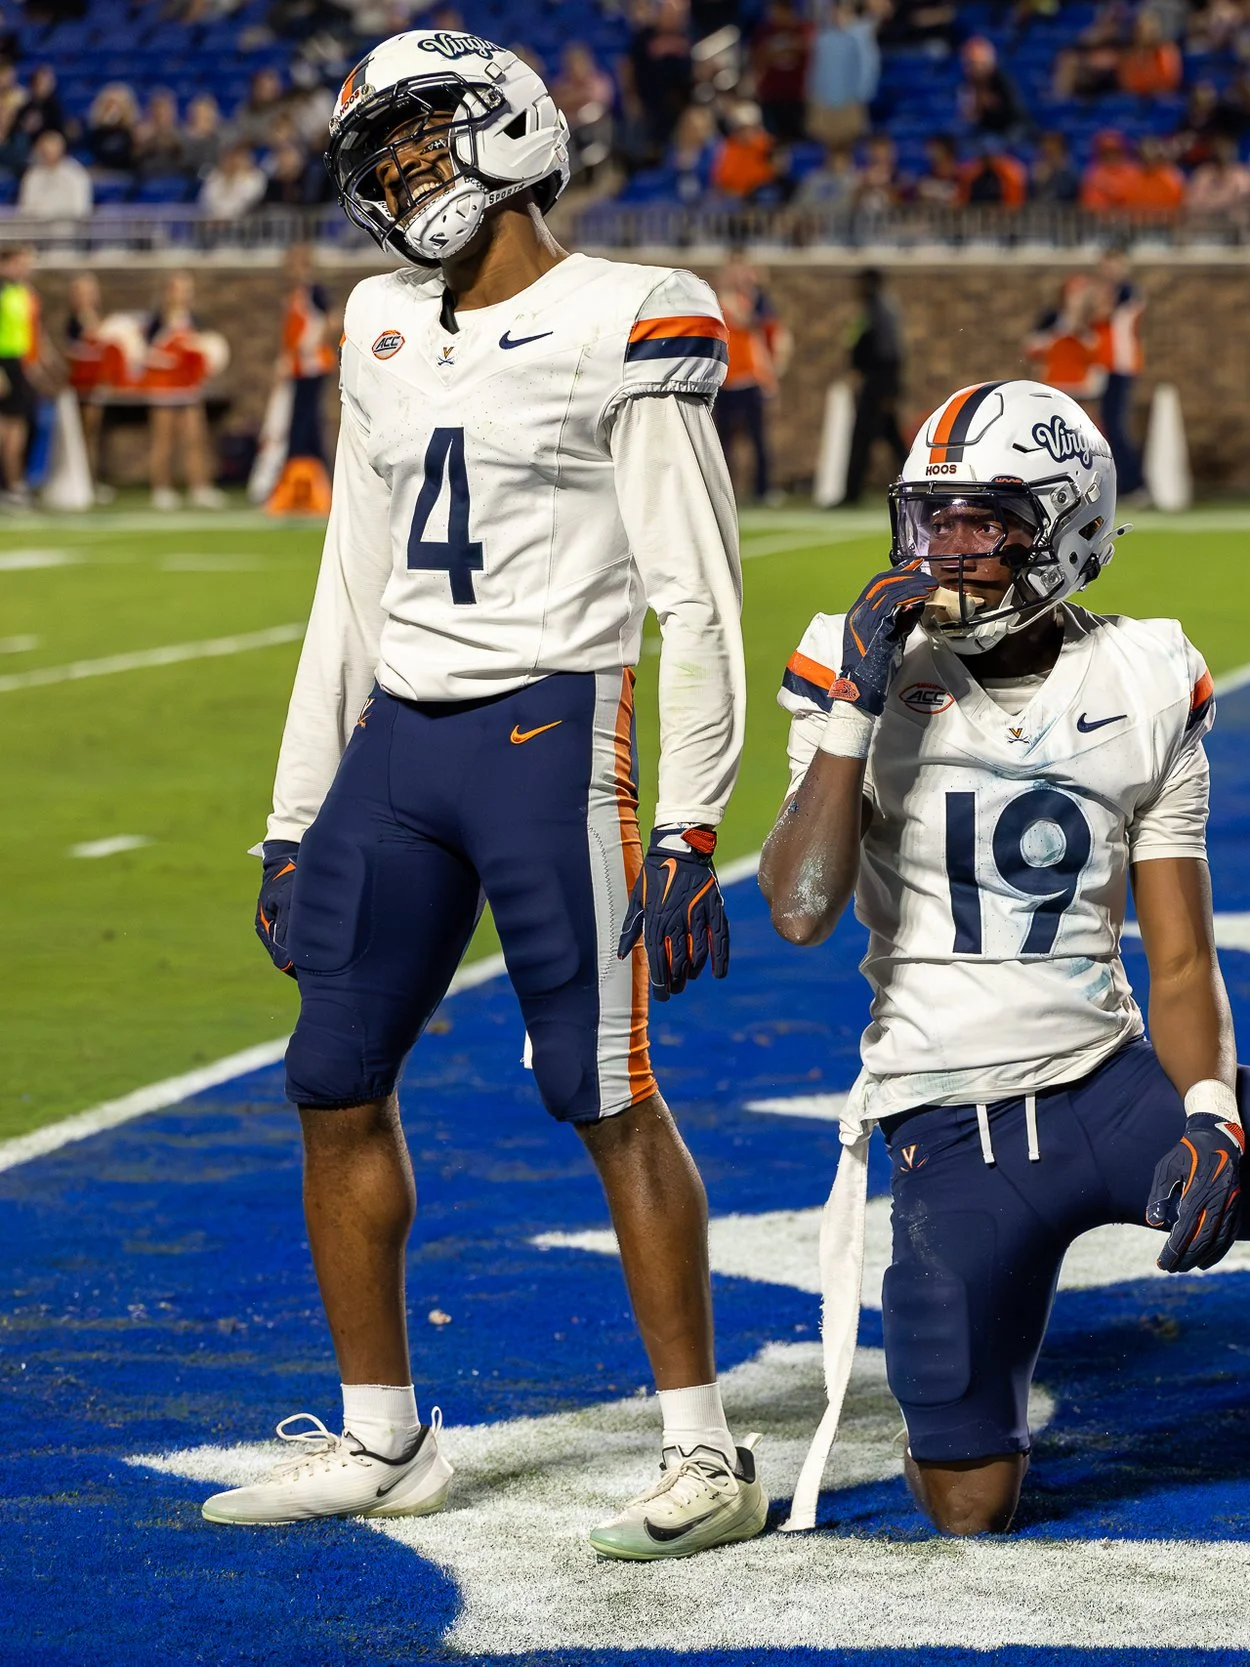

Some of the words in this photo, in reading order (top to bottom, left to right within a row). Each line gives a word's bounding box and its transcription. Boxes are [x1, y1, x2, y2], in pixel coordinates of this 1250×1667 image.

[375, 335, 402, 350] ACC
[925, 464, 957, 476] HOOS
[407, 427, 484, 604] 4
[907, 690, 947, 703] ACC
[945, 786, 1092, 954] 19
